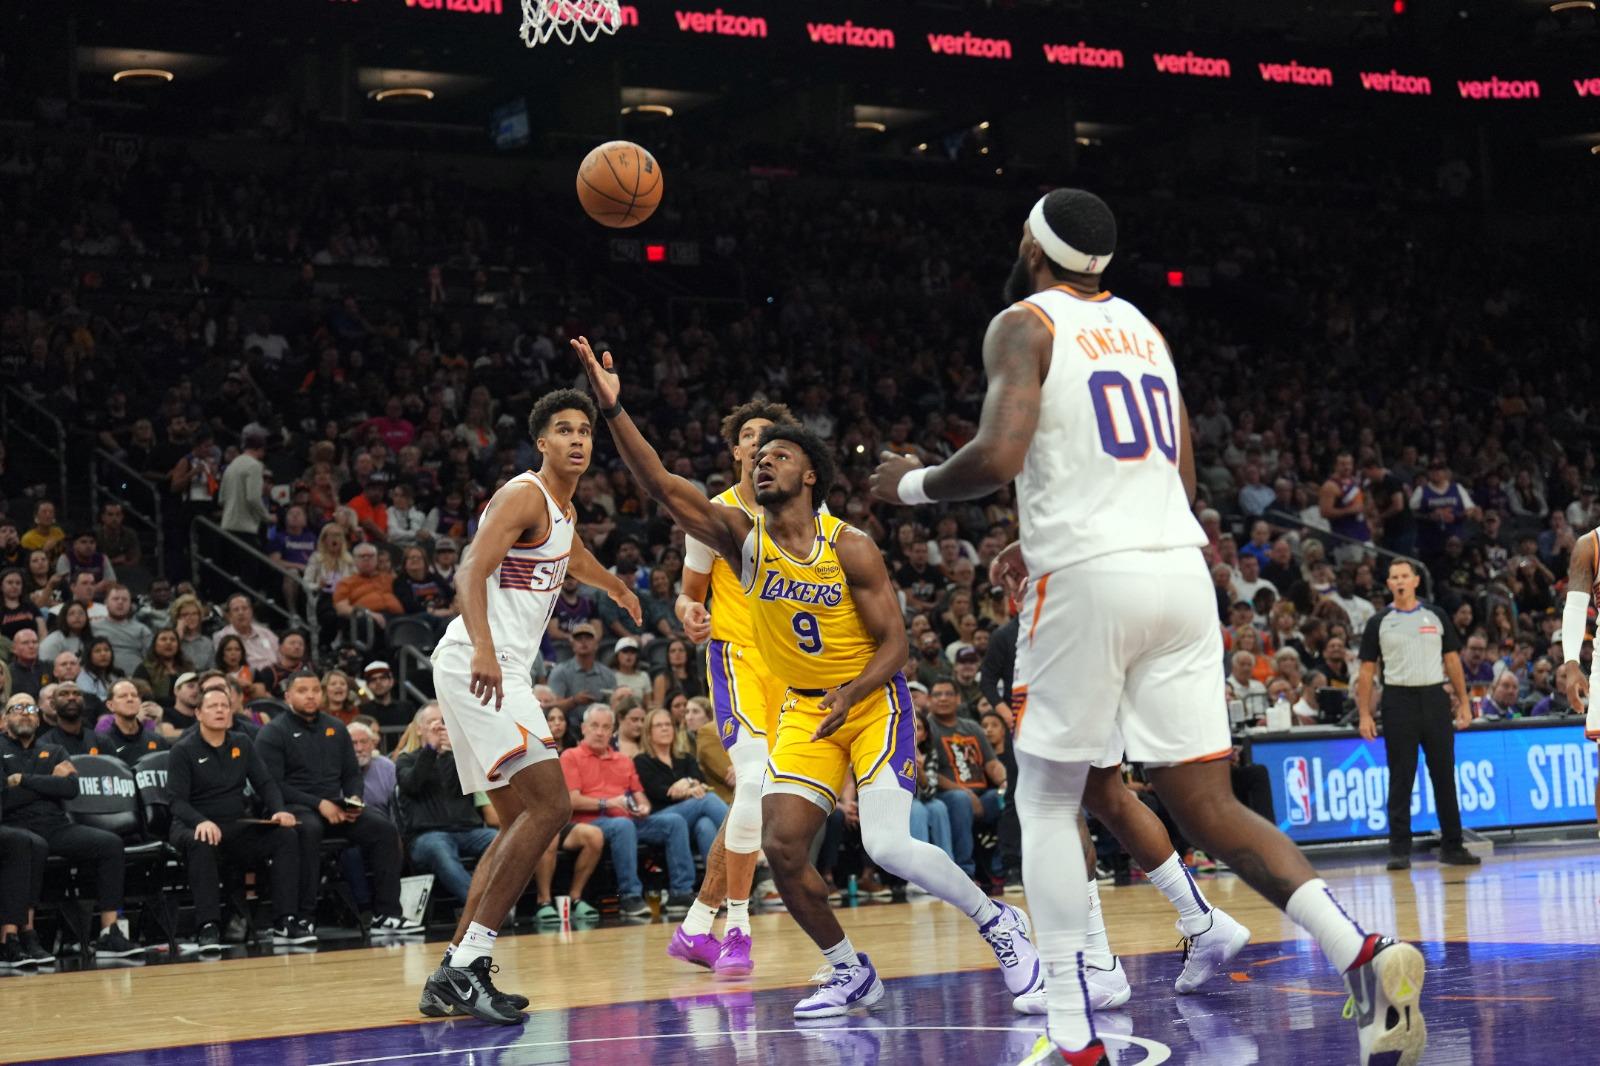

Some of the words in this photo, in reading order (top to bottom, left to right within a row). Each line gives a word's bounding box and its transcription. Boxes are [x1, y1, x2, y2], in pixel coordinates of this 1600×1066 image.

[675, 9, 767, 37] verizon
[807, 21, 895, 48] verizon
[928, 32, 1012, 58] verizon
[1043, 42, 1124, 68] verizon
[1153, 52, 1230, 77] verizon
[1259, 61, 1333, 86] verizon
[1360, 70, 1431, 94] verizon
[1457, 77, 1540, 98] verizon
[1076, 328, 1156, 365] O'NEALE
[1088, 371, 1177, 466] 00
[760, 571, 842, 608] LAKERS
[792, 611, 824, 655] 9
[78, 776, 101, 796] THE
[113, 776, 136, 797] App
[135, 770, 157, 789] GET
[1311, 757, 1420, 831] Leag
